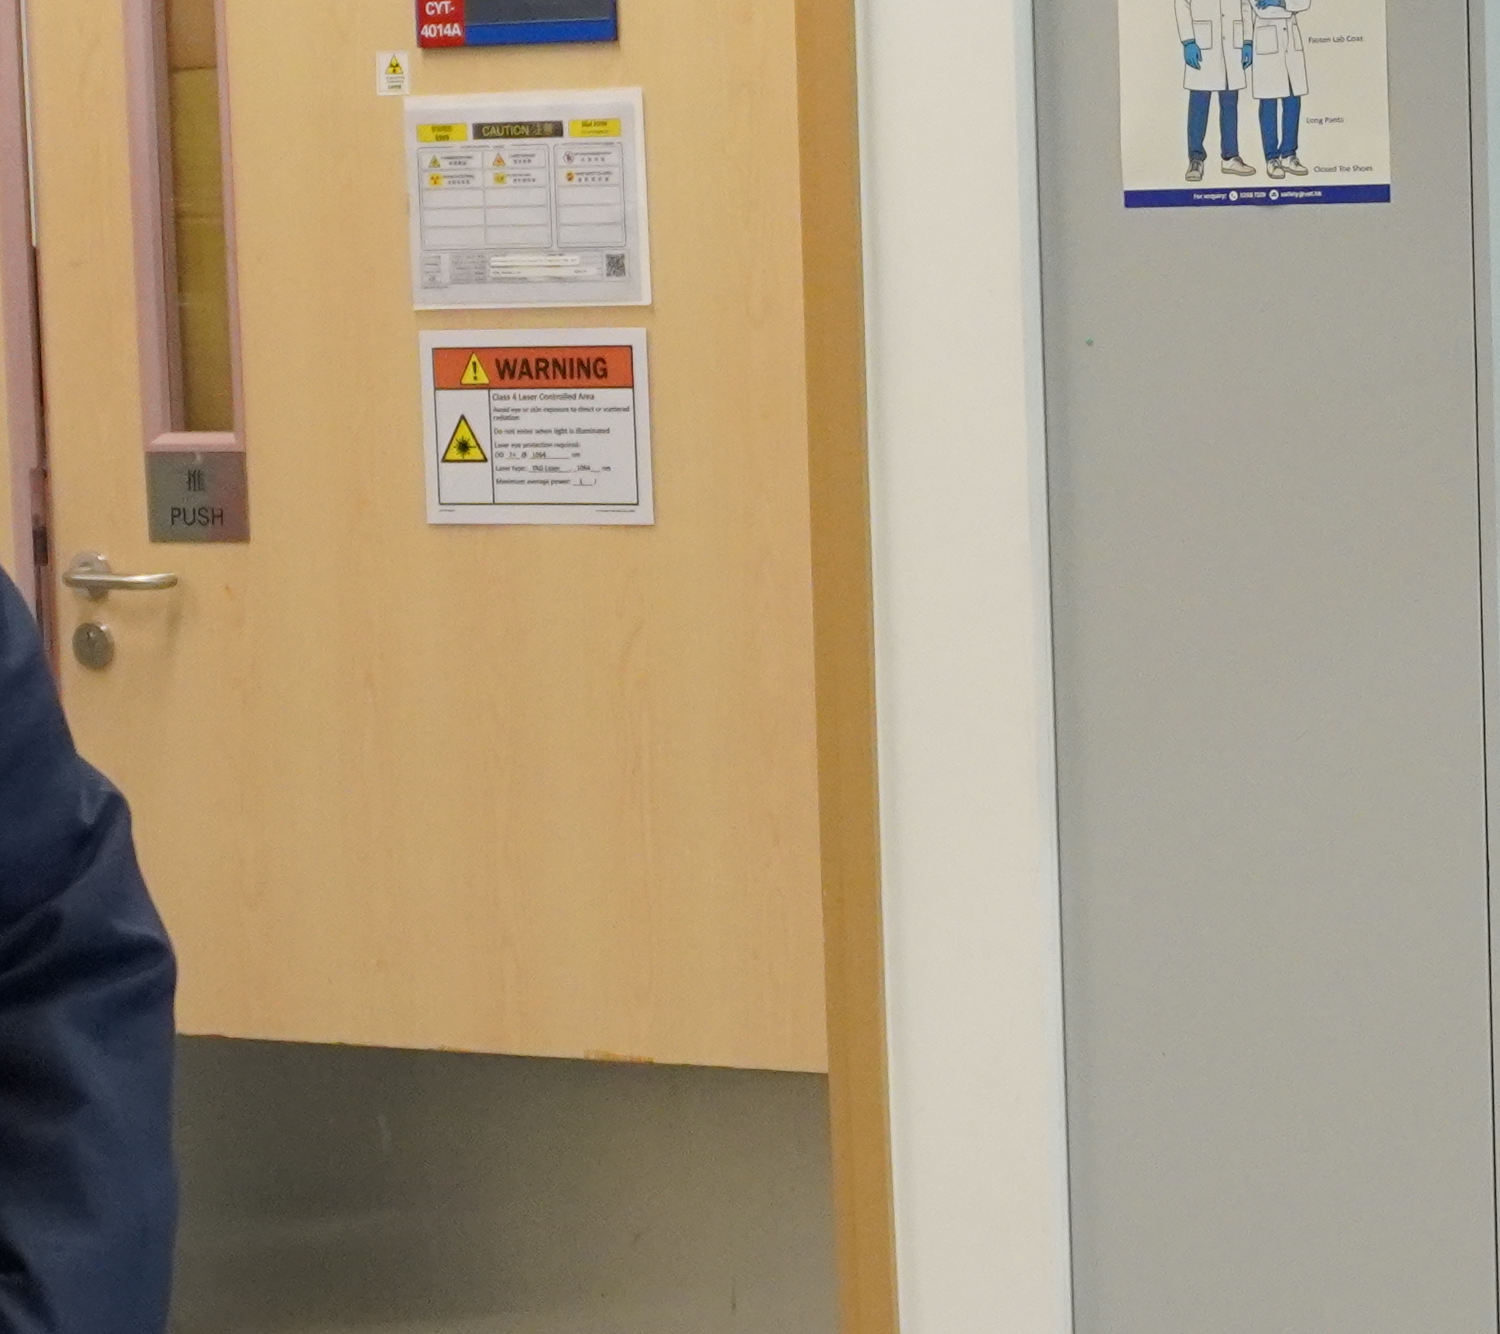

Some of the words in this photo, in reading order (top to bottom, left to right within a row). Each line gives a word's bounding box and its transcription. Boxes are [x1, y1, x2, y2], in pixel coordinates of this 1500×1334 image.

[425, 1, 455, 16] CYT-
[421, 23, 462, 38] 4014A
[1332, 35, 1345, 43] Lab
[1346, 35, 1363, 43] Coat
[1306, 117, 1323, 125] Long
[482, 124, 530, 136] CAUTION
[494, 357, 608, 381] WARNING
[492, 393, 510, 401] Class
[519, 393, 537, 401] Laser
[539, 392, 576, 401] Controlled
[554, 427, 567, 436] light
[171, 506, 224, 526] PUSH
